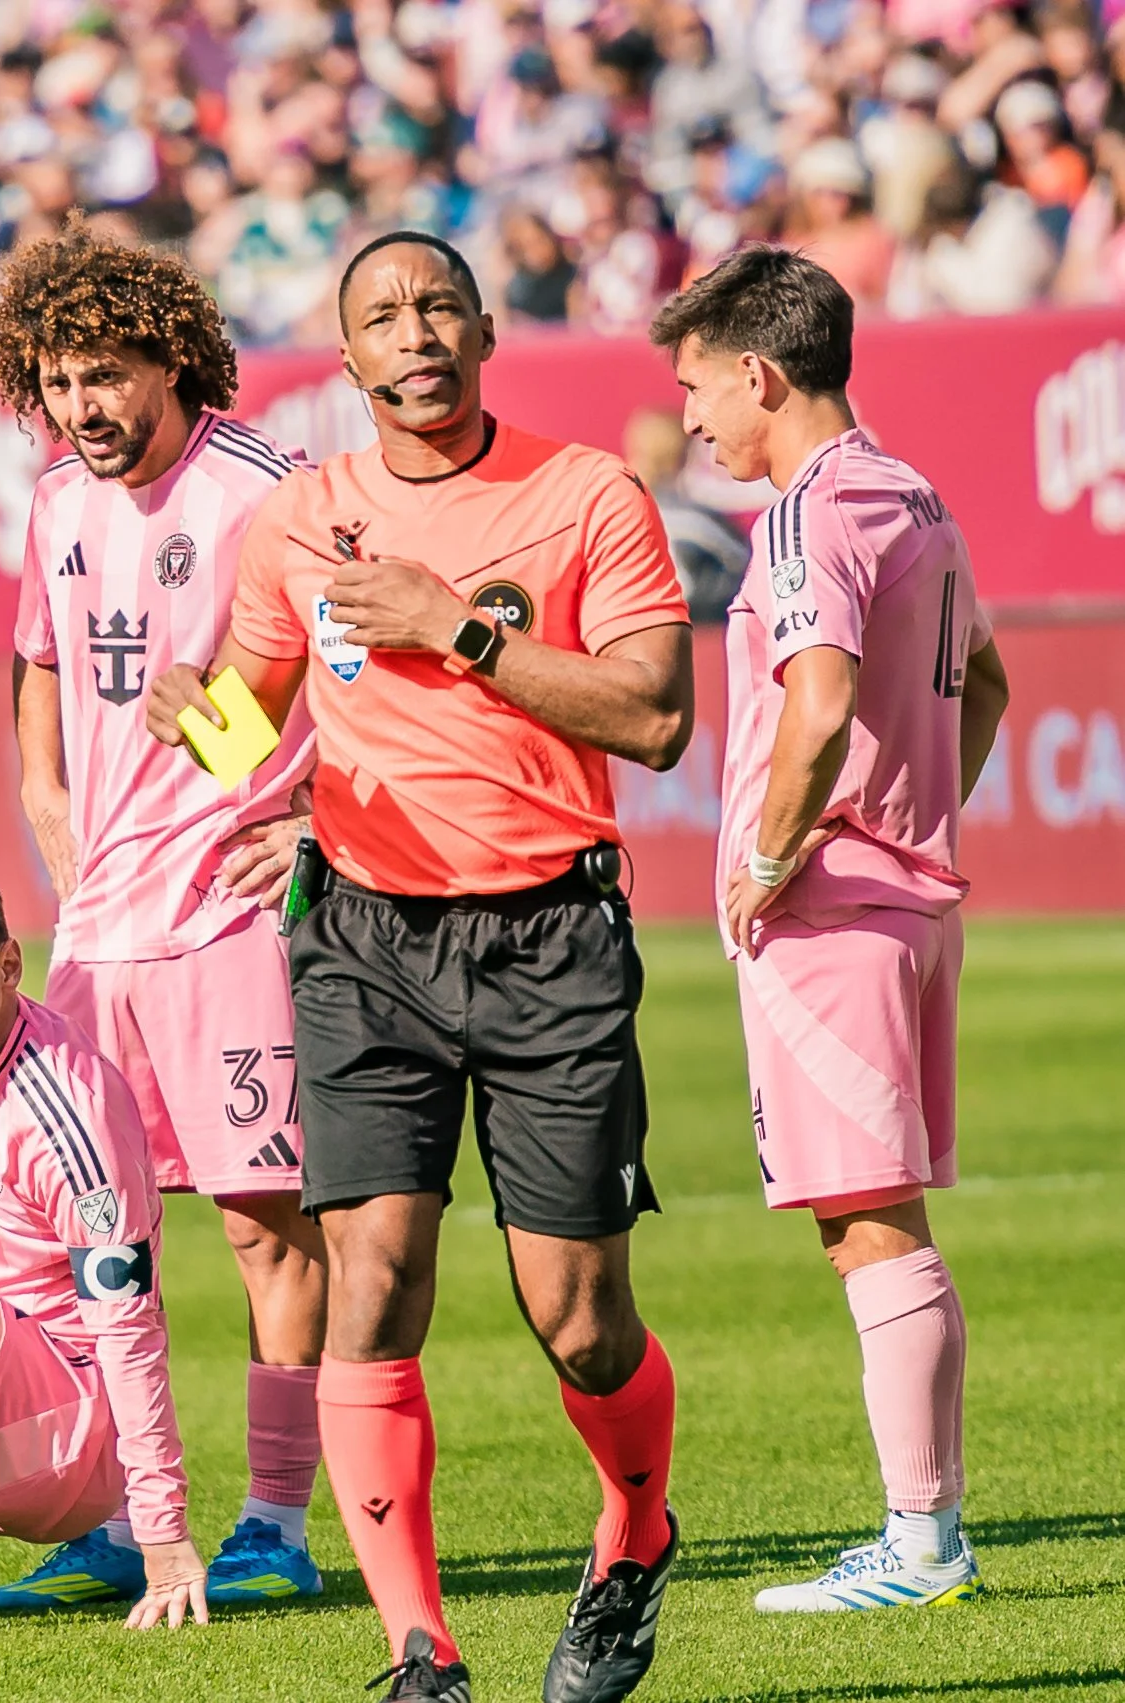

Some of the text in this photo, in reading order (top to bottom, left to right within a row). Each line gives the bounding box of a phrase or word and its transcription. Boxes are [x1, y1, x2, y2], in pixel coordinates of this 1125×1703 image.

[790, 609, 819, 631] tv
[321, 635, 346, 648] REFE
[222, 1045, 299, 1128] 37
[80, 1197, 101, 1210] MLS
[83, 1245, 141, 1301] C
